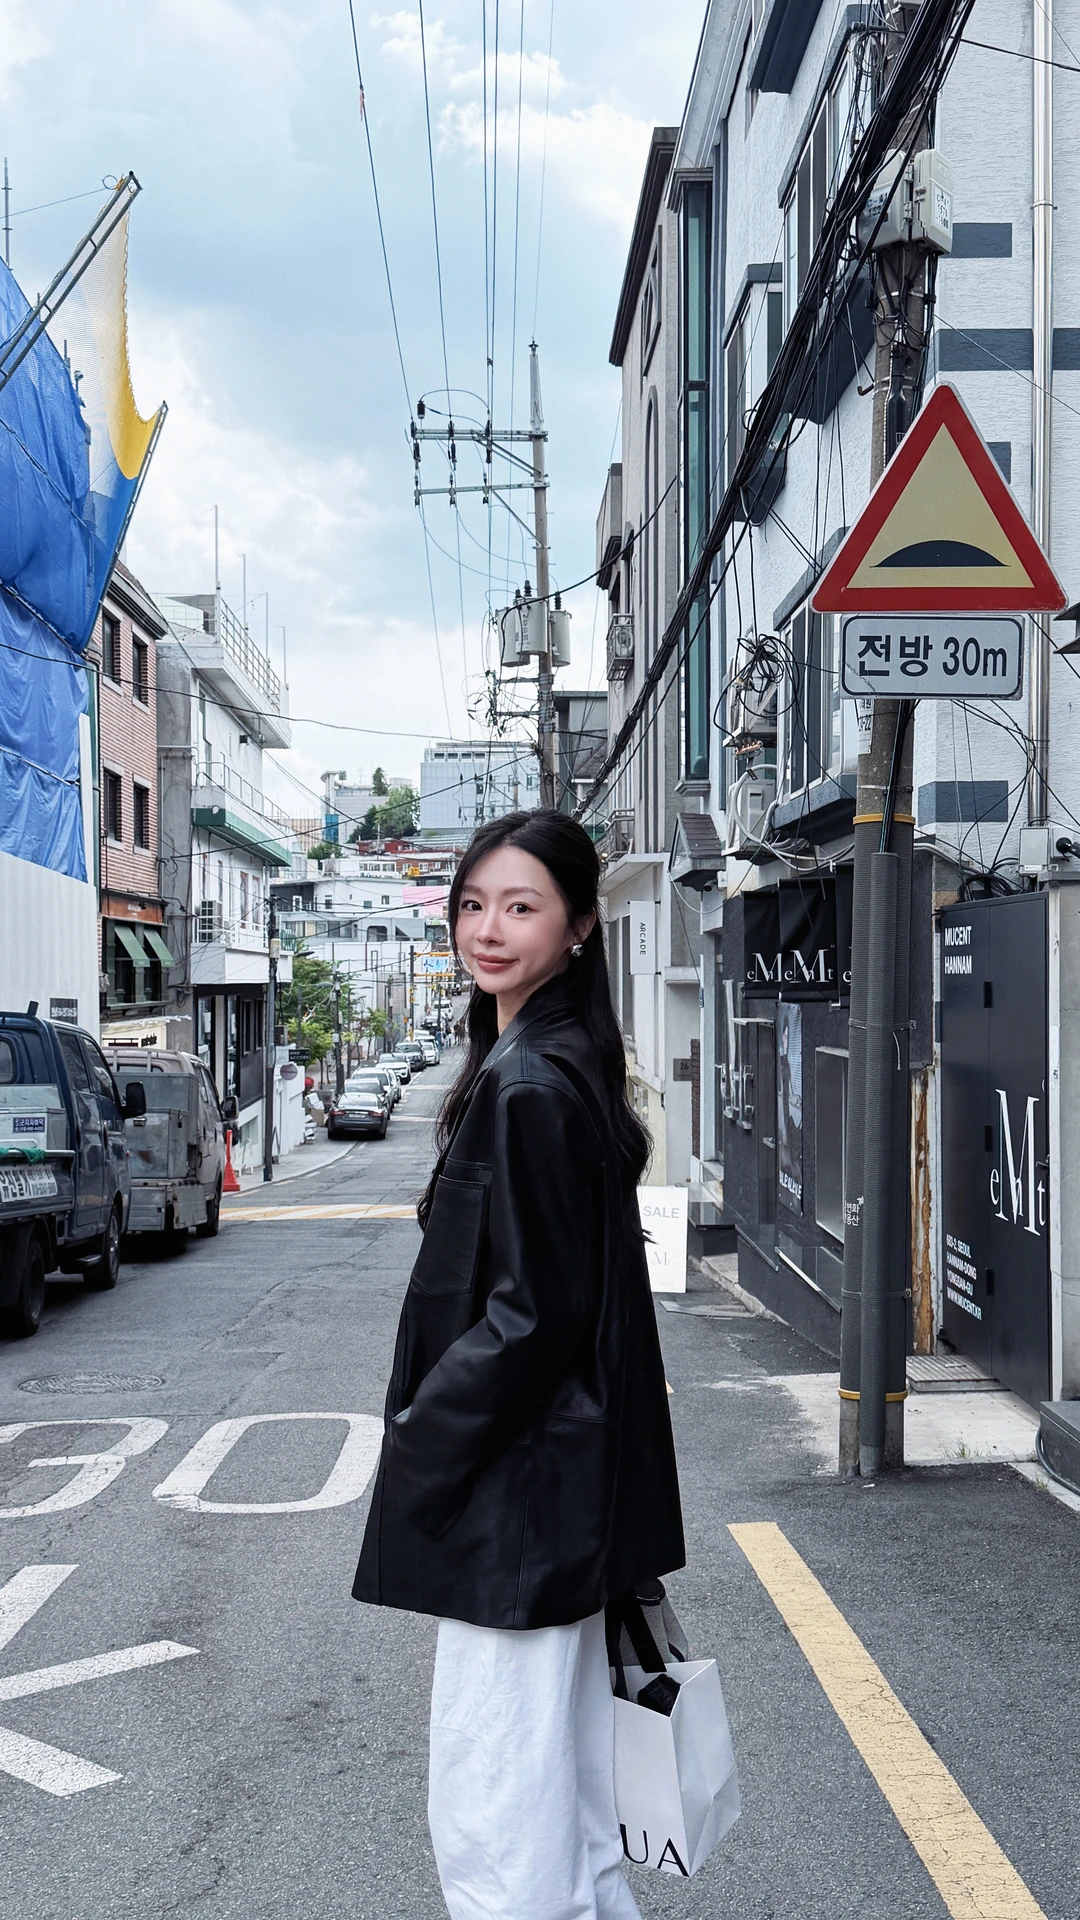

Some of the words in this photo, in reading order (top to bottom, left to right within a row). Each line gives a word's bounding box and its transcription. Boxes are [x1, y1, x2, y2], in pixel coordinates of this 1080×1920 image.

[857, 635, 933, 677] 전방
[943, 636, 1007, 677] 30m
[639, 922, 647, 955] ARCADE
[945, 926, 972, 946] MUCENT
[945, 955, 972, 975] HANNAM
[680, 1062, 689, 1071] 26
[643, 1205, 680, 1219] SALE
[957, 1240, 972, 1259] SEOUL
[946, 1251, 977, 1280] HANNAM-DONG
